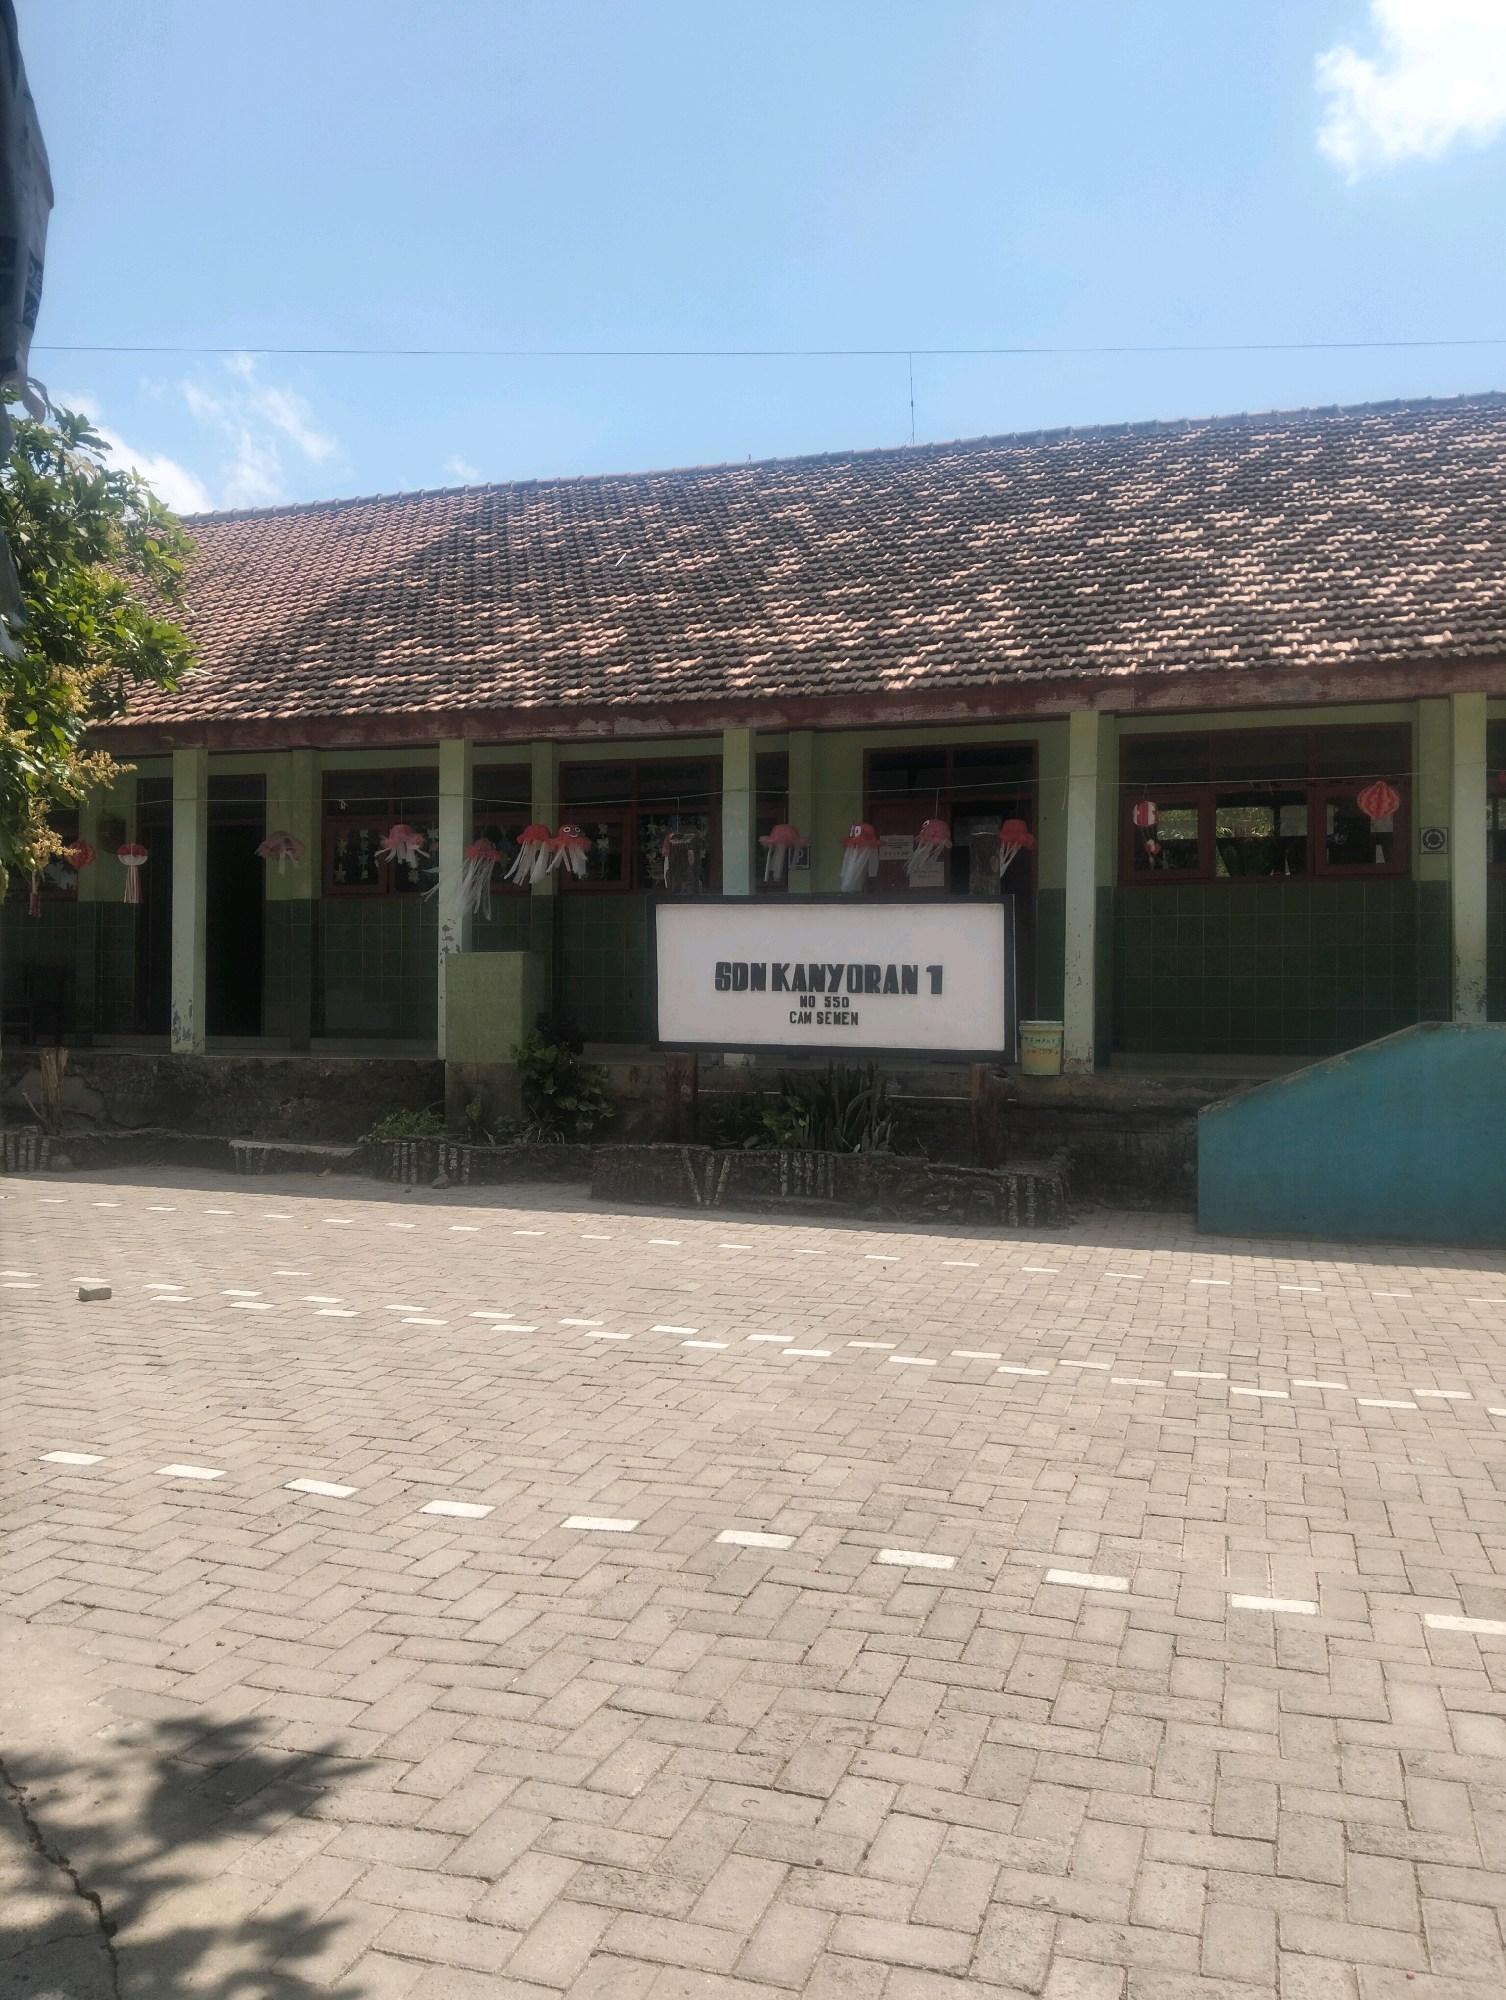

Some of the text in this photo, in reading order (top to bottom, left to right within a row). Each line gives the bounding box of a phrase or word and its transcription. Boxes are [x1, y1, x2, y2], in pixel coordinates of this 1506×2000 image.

[714, 962, 943, 995] SDN KANYORAN 1
[799, 995, 850, 1008] NO 550
[789, 1010, 859, 1026] CAM SEMEN
